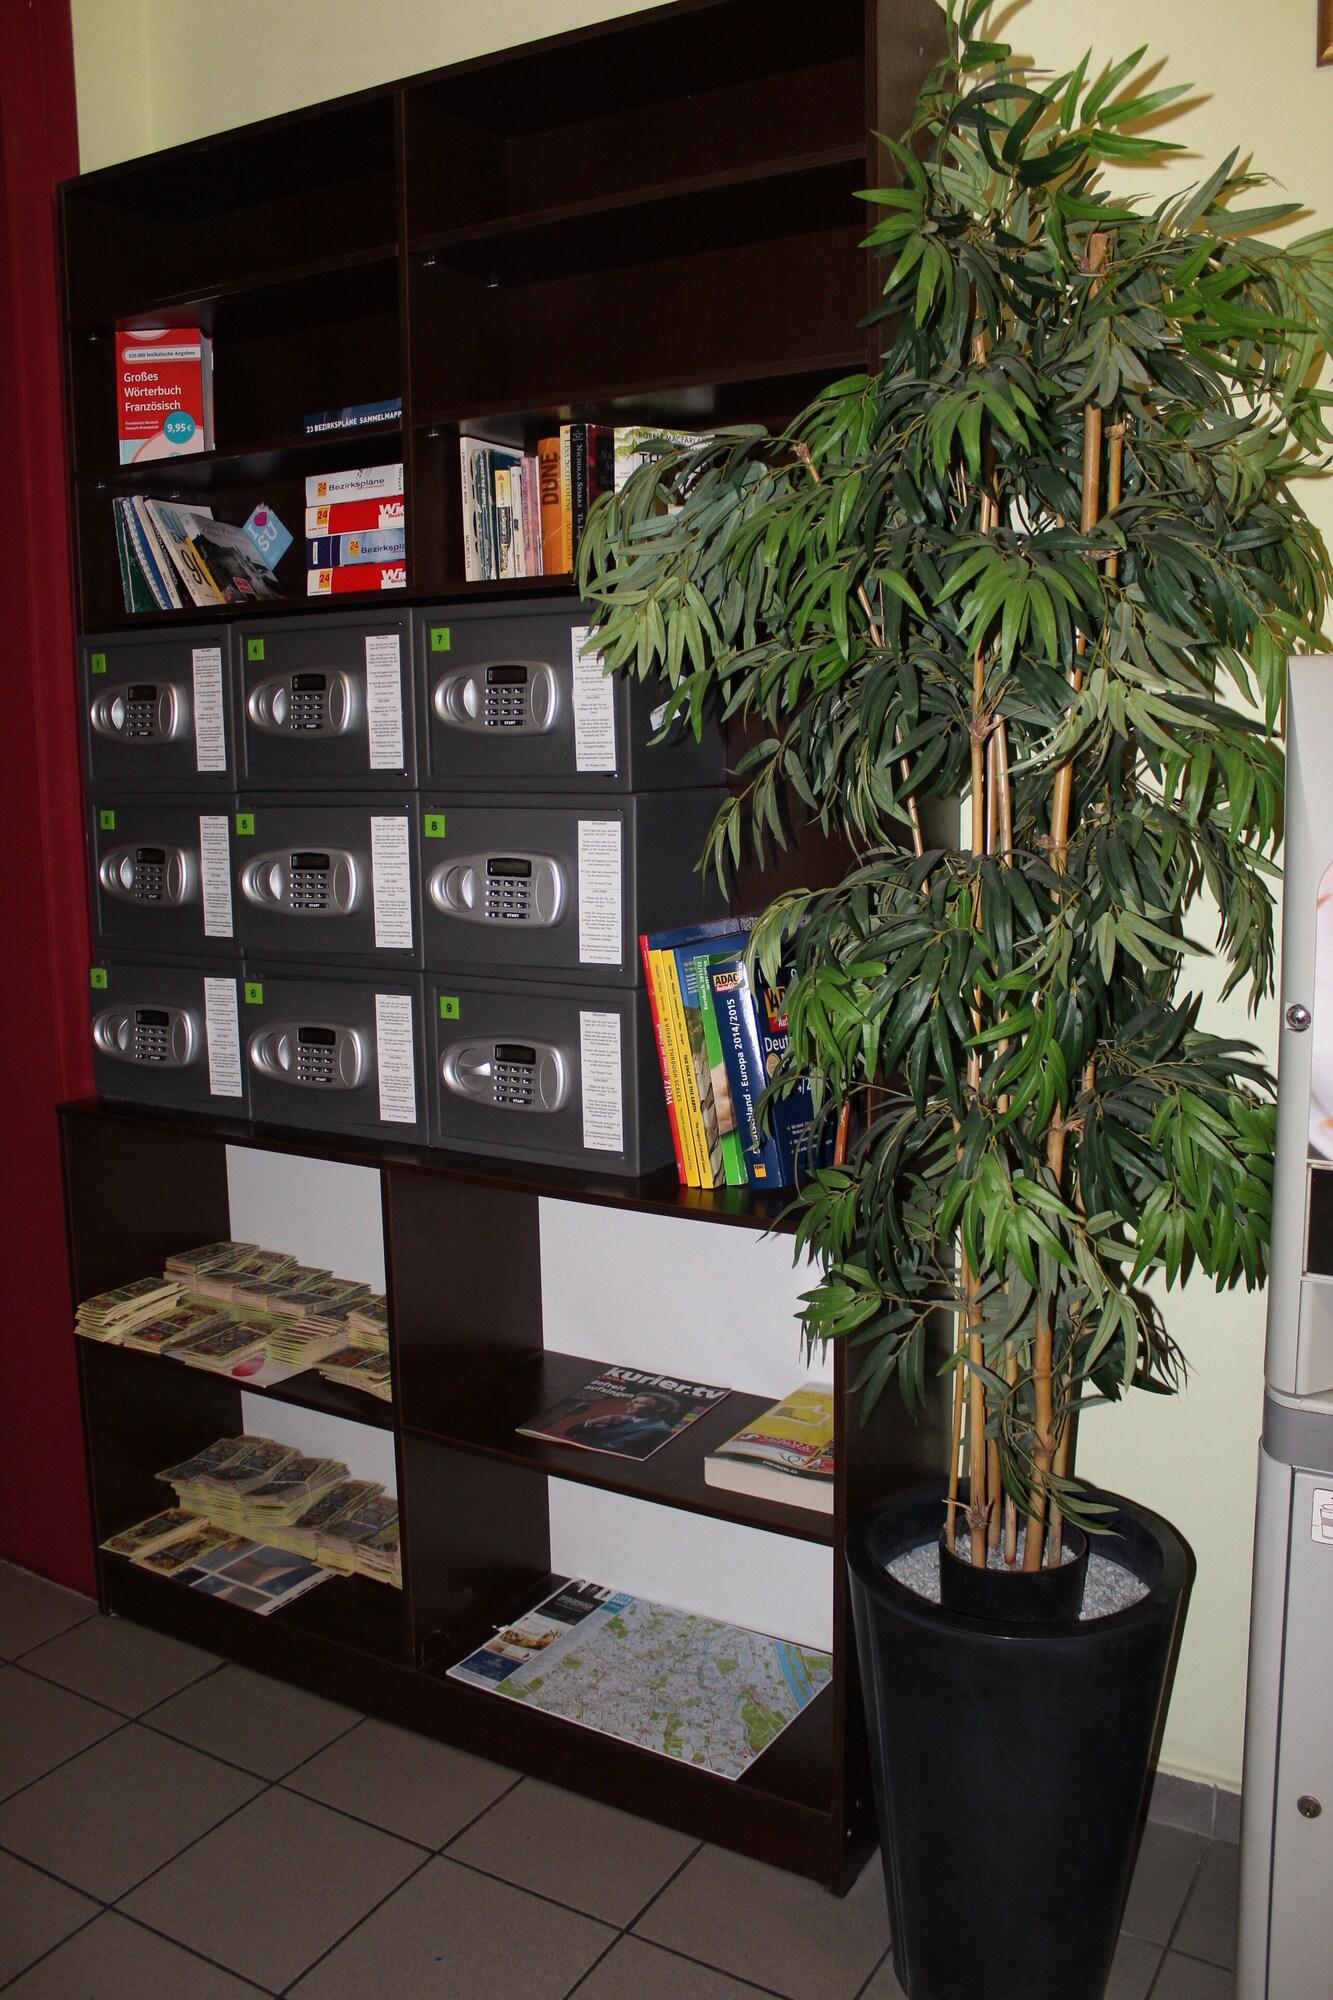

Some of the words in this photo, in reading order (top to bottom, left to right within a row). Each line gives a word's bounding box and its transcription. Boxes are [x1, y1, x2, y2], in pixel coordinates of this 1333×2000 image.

[123, 371, 159, 382] Großes
[124, 385, 182, 397] Wörterbuch
[125, 400, 181, 412] Französisch
[167, 423, 186, 434] 9,95
[306, 425, 314, 433] 23
[314, 417, 357, 432] BEZIRKSPLÄNE
[317, 481, 327, 491] 24
[328, 478, 385, 491] Bezirkspläne
[541, 451, 560, 506] DUNE
[316, 509, 328, 520] 24
[350, 541, 359, 551] 24
[319, 573, 330, 583] 24
[437, 634, 443, 645] 7
[715, 972, 739, 986] ADAC
[446, 1003, 452, 1013] 9
[726, 999, 743, 1050] 2014/2015
[664, 1022, 673, 1046] VOYAGE
[669, 1047, 679, 1077] THROUGH
[674, 1078, 682, 1102] SCALES
[738, 1052, 749, 1087] Europa
[604, 1367, 726, 1399] kurier.tv
